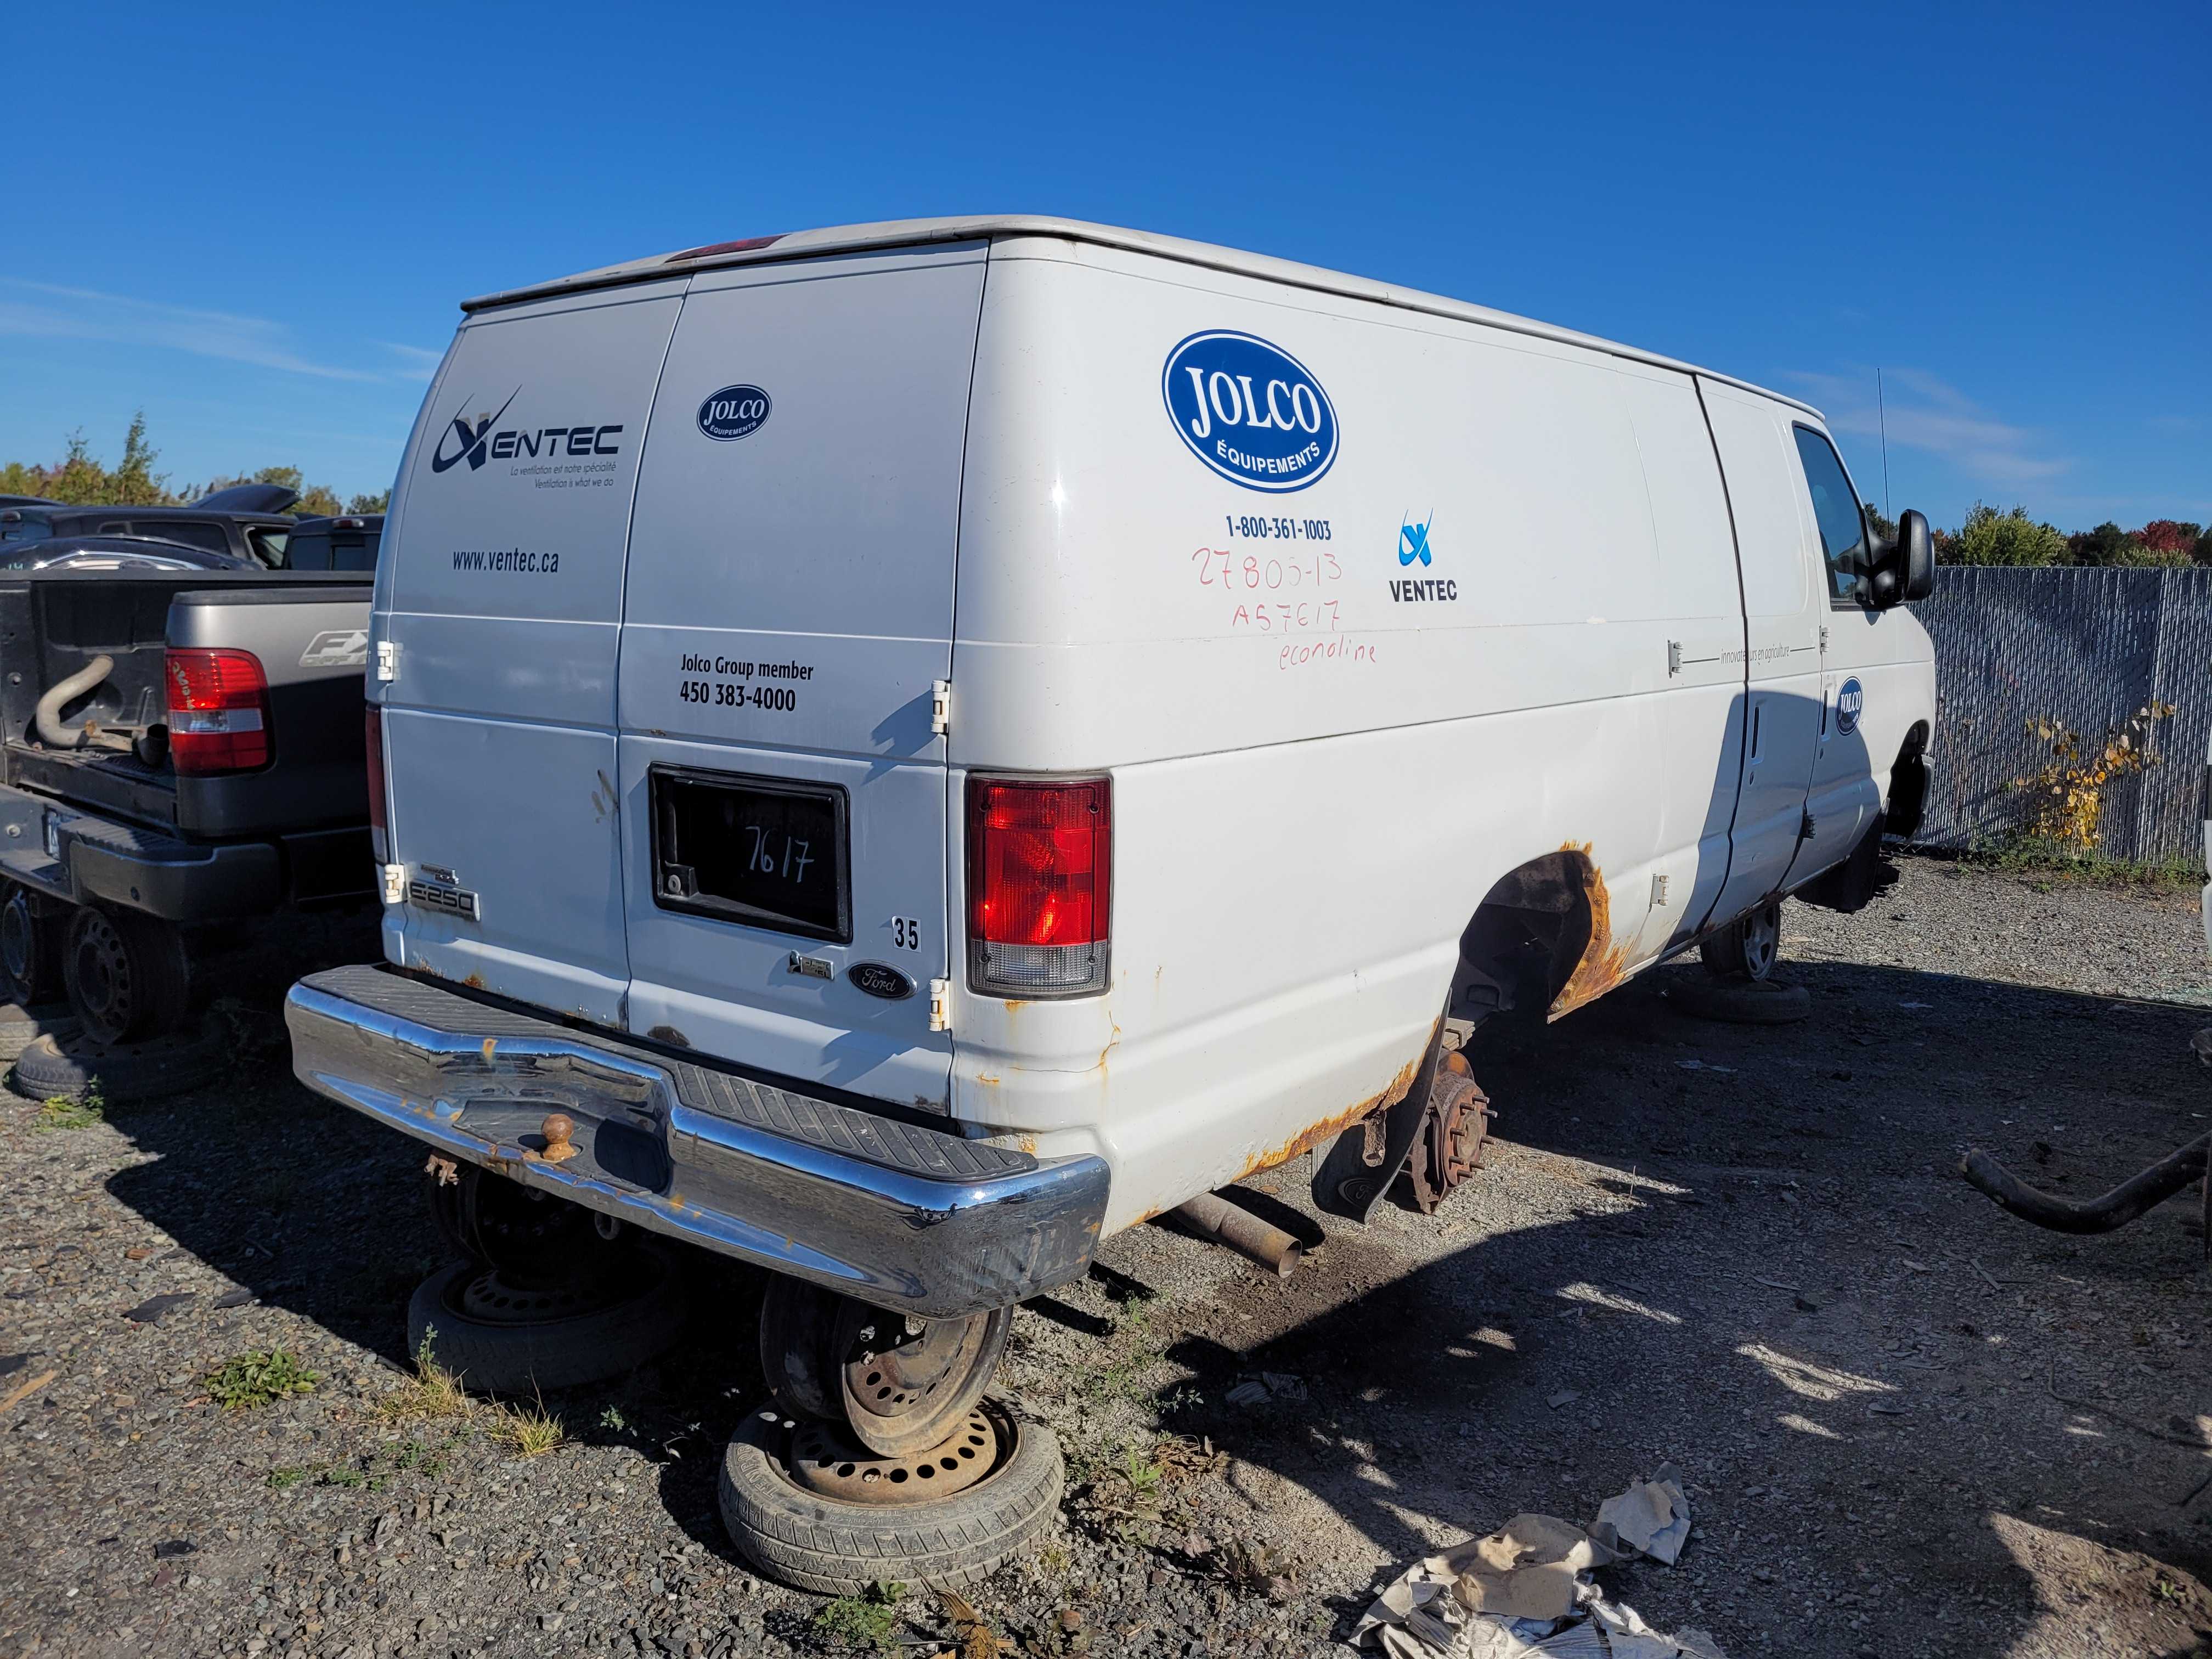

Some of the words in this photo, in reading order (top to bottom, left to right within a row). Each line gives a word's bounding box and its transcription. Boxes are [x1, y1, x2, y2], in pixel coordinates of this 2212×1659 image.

[703, 399, 765, 426] JOLCO
[1185, 366, 1321, 438] JOLCO
[709, 420, 757, 436] ÉQUIPEMENTS
[1216, 439, 1321, 474] ÉQUIPEMENTS
[510, 465, 518, 476] La
[592, 478, 602, 487] we
[604, 478, 614, 487] do
[1226, 515, 1332, 540] 1-800-361-1003
[453, 547, 559, 573] www.ventec.ca
[1389, 579, 1458, 602] VENTEC
[1279, 634, 1376, 670] econoline
[1758, 649, 1764, 661] en
[1765, 642, 1790, 663] agriculture
[681, 653, 711, 673] Jolco
[715, 656, 754, 680] Group
[758, 660, 814, 680] member
[680, 681, 710, 704] 450
[715, 684, 796, 712] 383-4000
[1838, 691, 1861, 721] JOLCO
[410, 881, 473, 912] E-250
[894, 918, 918, 950] 35
[861, 968, 896, 992] Ford
